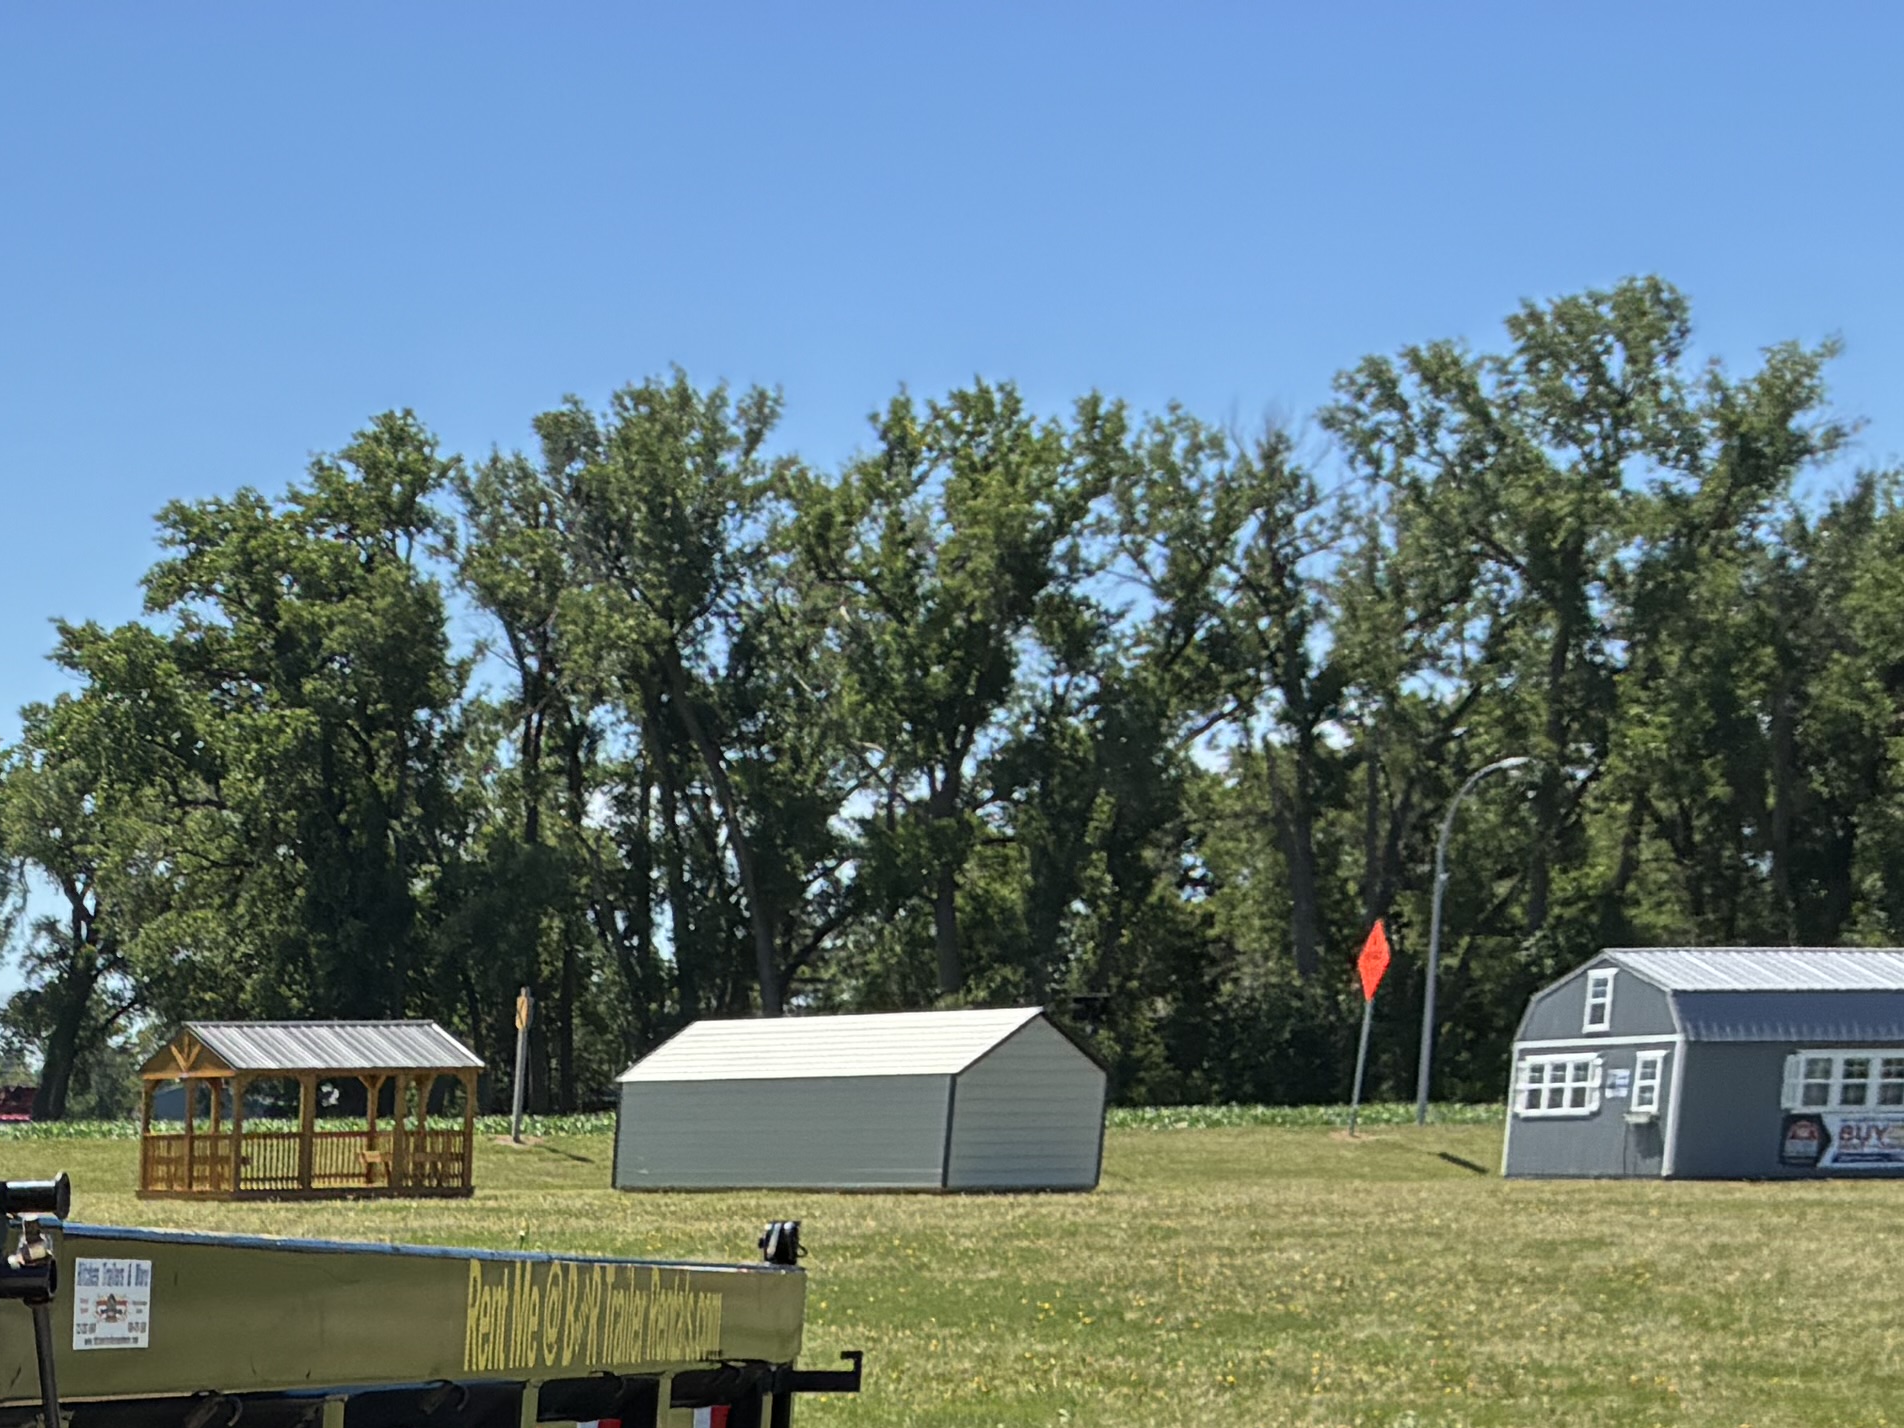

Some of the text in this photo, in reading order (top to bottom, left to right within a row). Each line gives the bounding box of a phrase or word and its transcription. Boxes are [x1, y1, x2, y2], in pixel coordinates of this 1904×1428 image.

[464, 1258, 509, 1371] Rent
[509, 1260, 540, 1368] Me
[544, 1260, 563, 1367] @
[602, 1264, 648, 1364] Trailer
